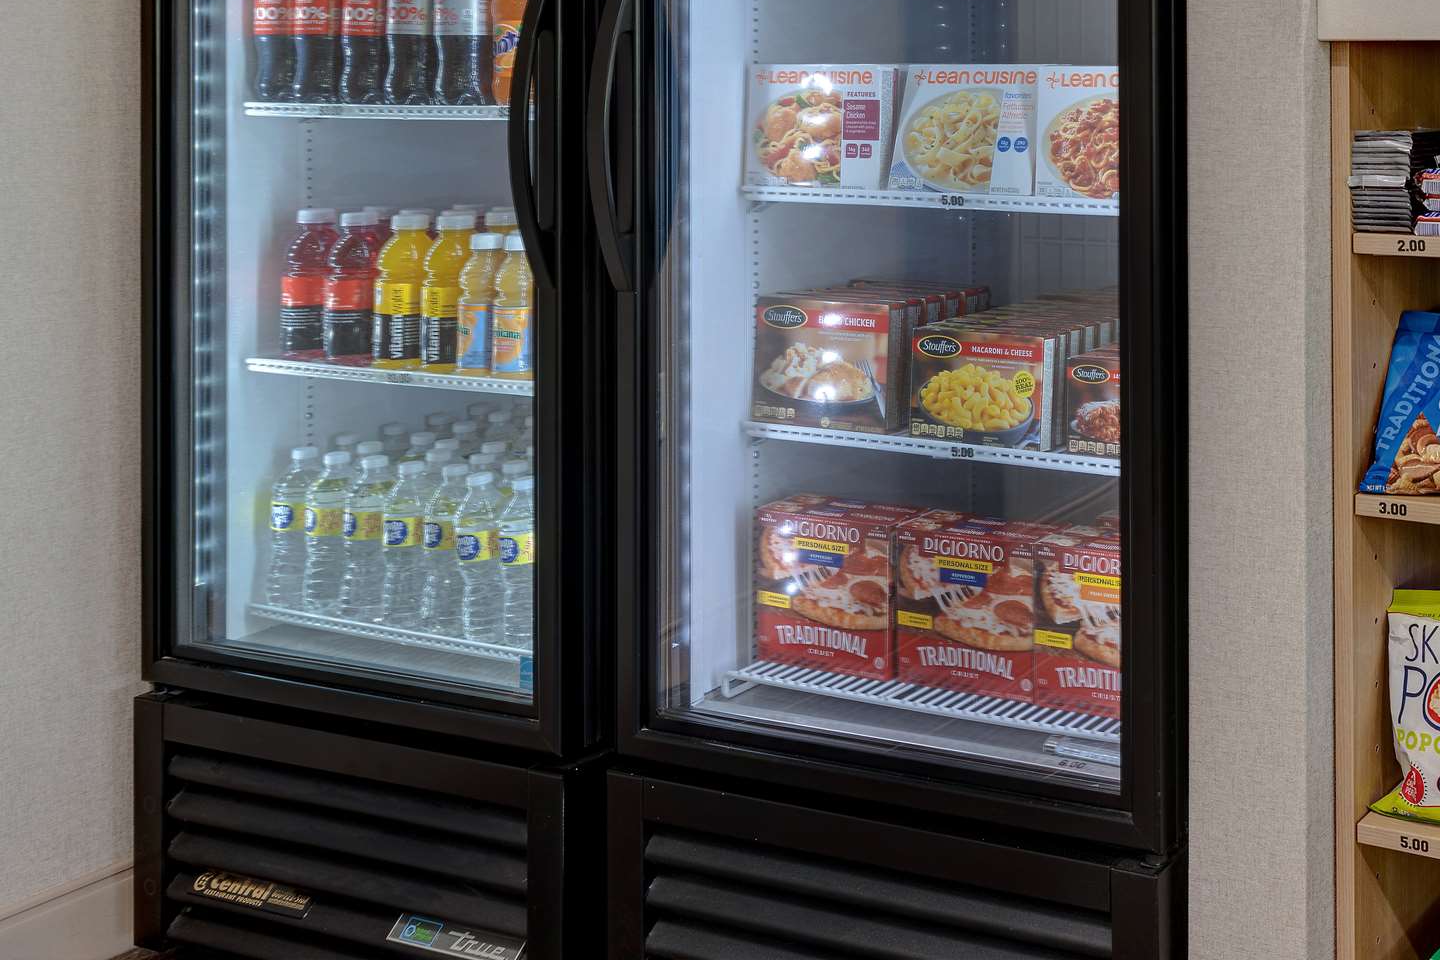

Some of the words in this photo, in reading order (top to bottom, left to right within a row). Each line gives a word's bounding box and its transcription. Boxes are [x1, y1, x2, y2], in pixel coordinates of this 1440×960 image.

[941, 195, 965, 206] 5.00
[1397, 239, 1426, 252] 2.00
[767, 309, 803, 325] Stouffer's
[844, 317, 876, 328] CHICKEN
[389, 314, 404, 359] vitamin
[427, 317, 440, 362] vitamin
[922, 338, 957, 354] Stouffer's
[971, 345, 1003, 355] MACARONI
[1004, 348, 1010, 356] &
[1010, 348, 1034, 358] CHEESE
[1076, 367, 1108, 381] Stouffer's
[951, 446, 974, 458] 5.00
[1378, 501, 1407, 516] 3.00
[798, 540, 831, 551] PERSONAL
[831, 544, 846, 552] SIZE
[938, 558, 973, 570] PERSONAL
[974, 562, 989, 572] SIZE
[774, 625, 869, 659] TRADITIONAL
[916, 646, 1015, 681] TRADITIONAL
[1399, 836, 1429, 853] 5.00
[210, 878, 275, 900] Central
